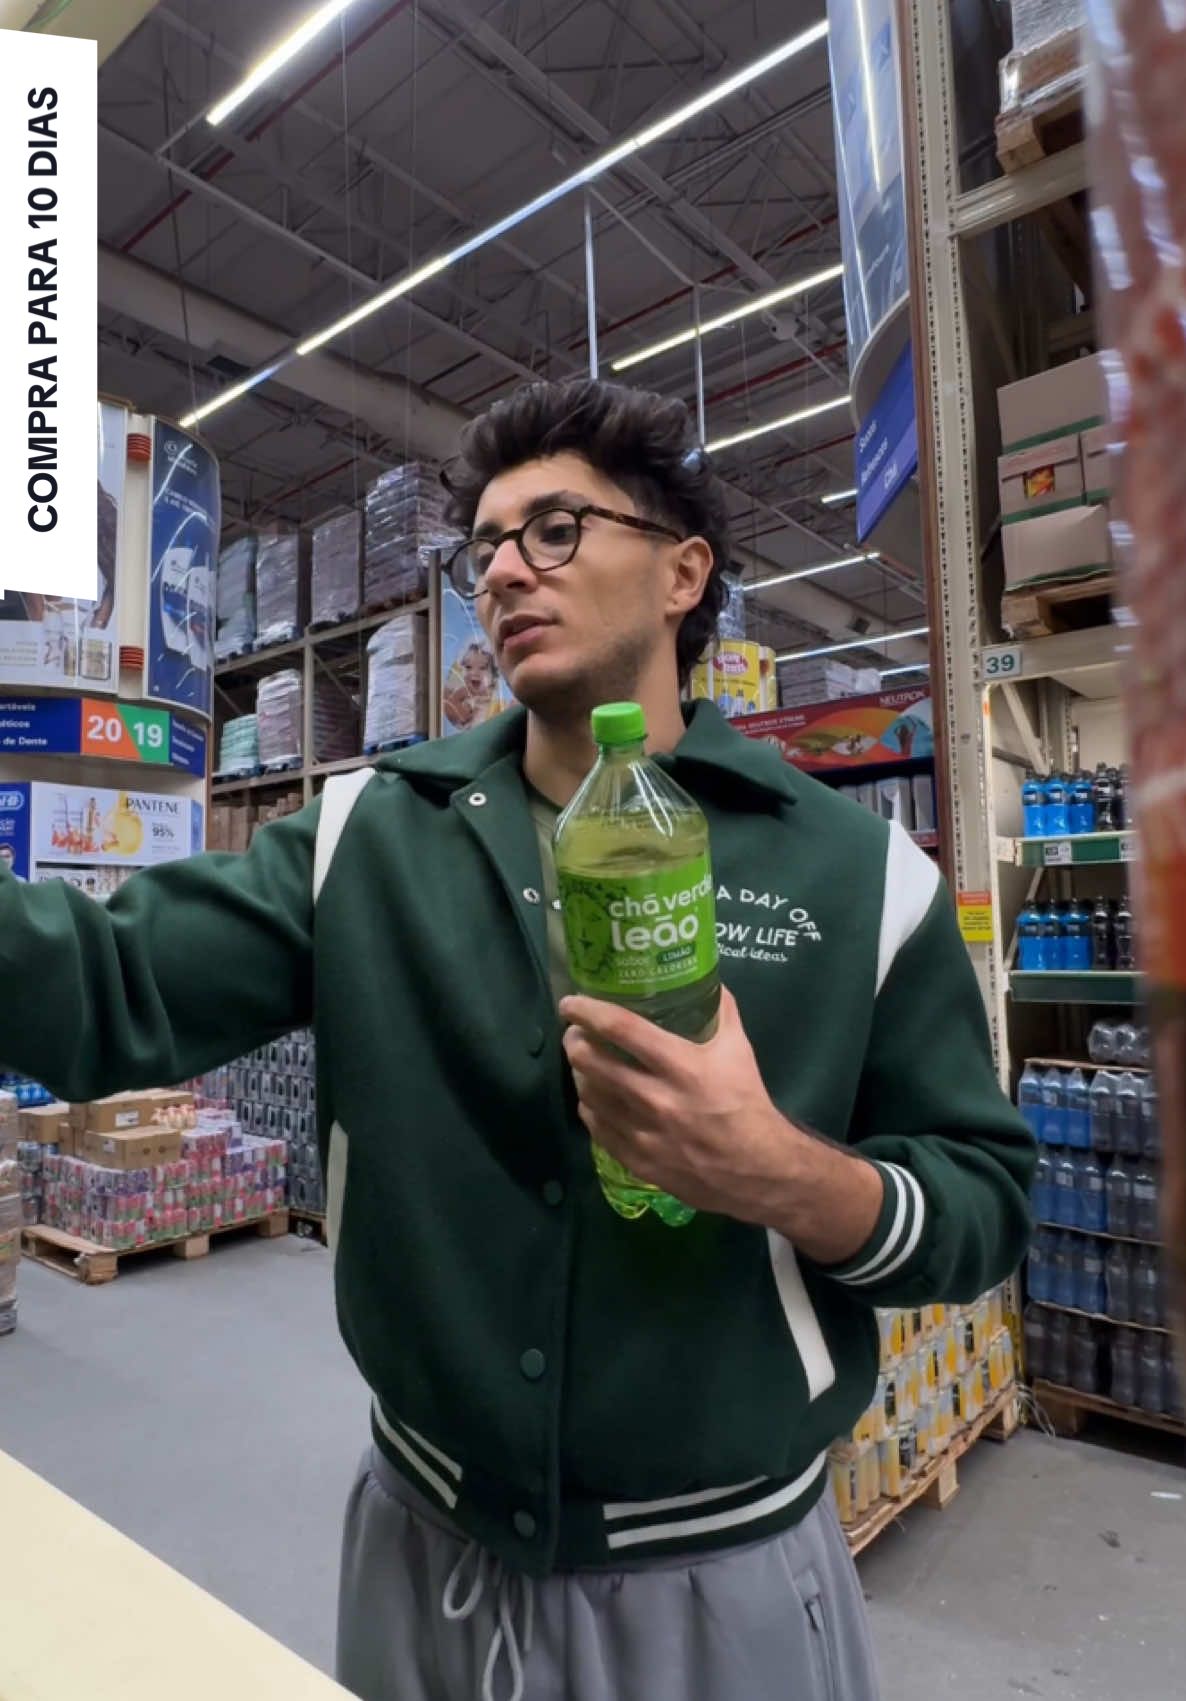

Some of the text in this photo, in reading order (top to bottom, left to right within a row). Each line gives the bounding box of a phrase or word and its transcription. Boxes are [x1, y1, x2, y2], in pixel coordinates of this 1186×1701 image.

[986, 653, 1015, 674] 39
[87, 714, 123, 742] 20
[133, 722, 163, 749] 19
[18, 736, 48, 747] Dente
[125, 797, 179, 815] PANTENE
[716, 885, 822, 941] A DAY OFF
[755, 927, 799, 946] LIFE
